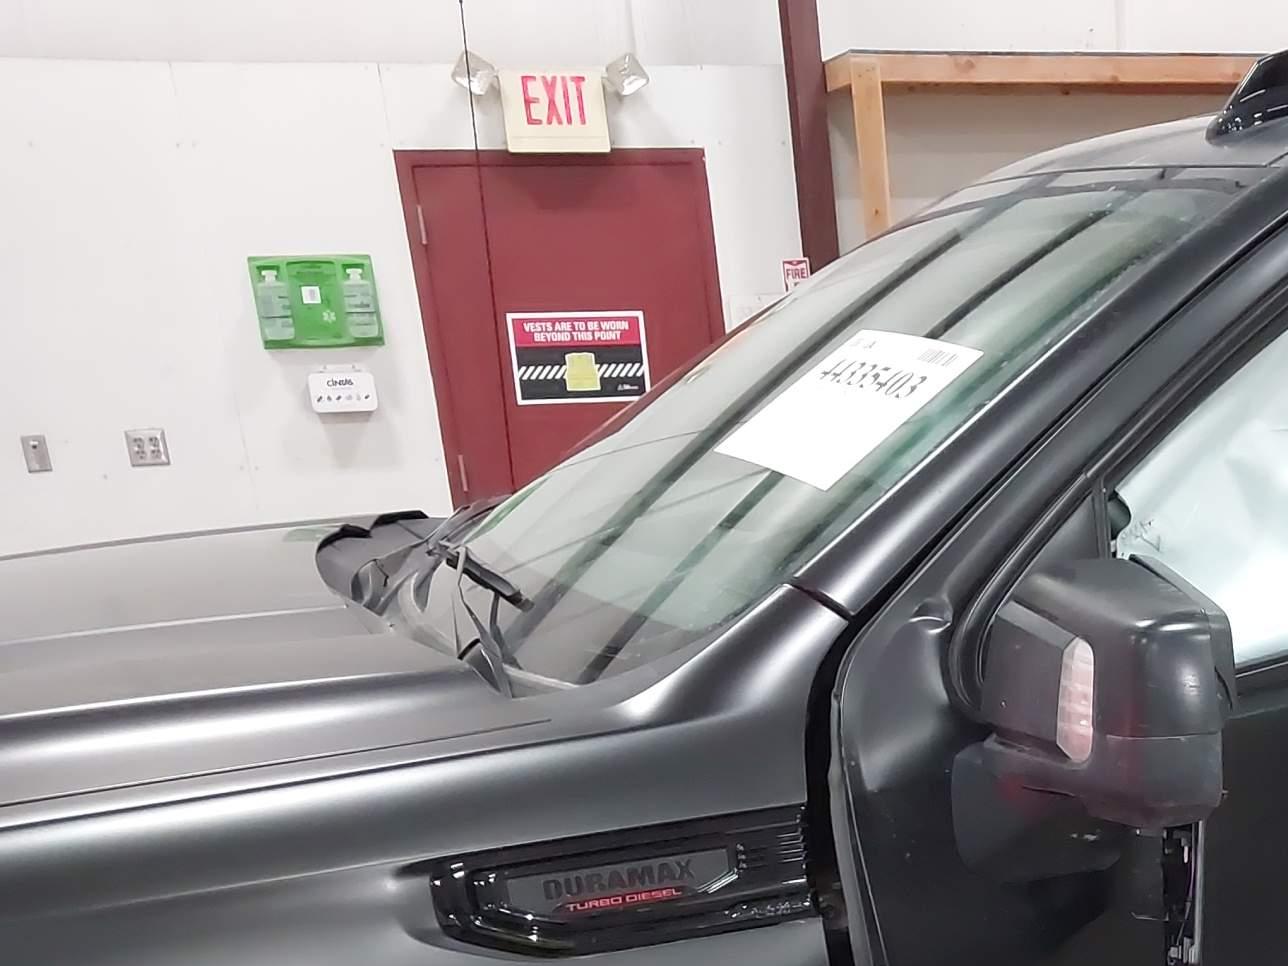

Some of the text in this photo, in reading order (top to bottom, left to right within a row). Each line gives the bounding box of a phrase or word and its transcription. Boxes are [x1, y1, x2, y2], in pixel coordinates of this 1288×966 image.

[520, 75, 586, 126] EXIT
[786, 267, 807, 280] FIRE
[523, 320, 629, 333] VESTS ARE TO BE WORN
[533, 330, 621, 342] BEYOND THIS POINT
[820, 358, 928, 399] 44335403
[542, 858, 696, 901] DURAMAX
[565, 887, 683, 912] TURBO DIESEL
